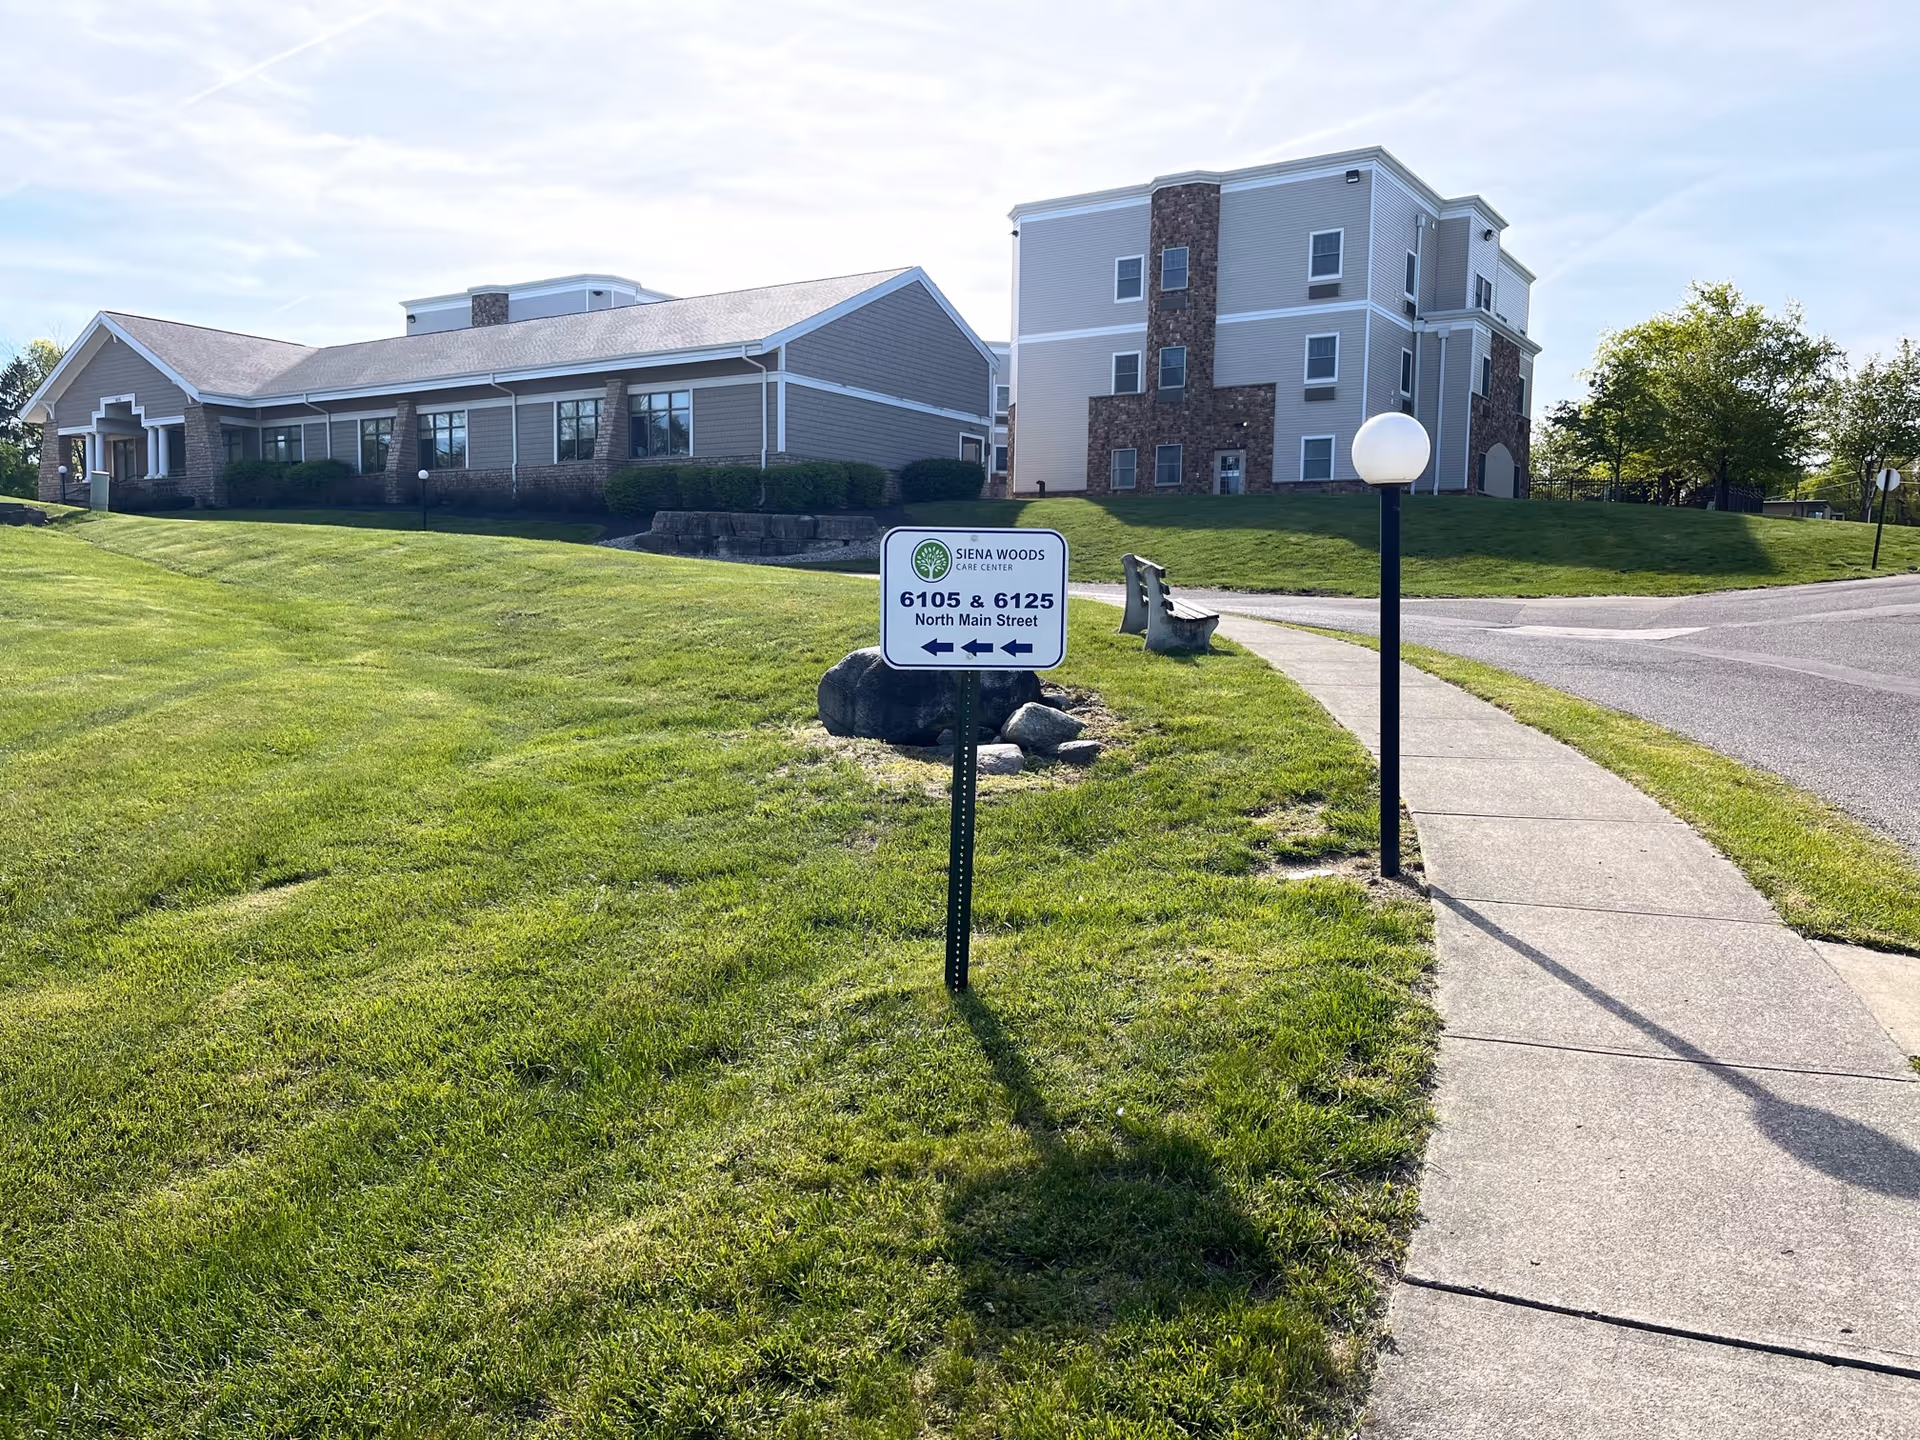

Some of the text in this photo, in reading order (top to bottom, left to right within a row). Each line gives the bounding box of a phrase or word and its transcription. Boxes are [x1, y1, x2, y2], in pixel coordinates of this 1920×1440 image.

[955, 548, 1046, 561] SIENA WOODS
[955, 563, 1014, 572] CARE CENTER
[900, 591, 1055, 610] 6105 & 6125
[915, 612, 1039, 628] North Main Street
